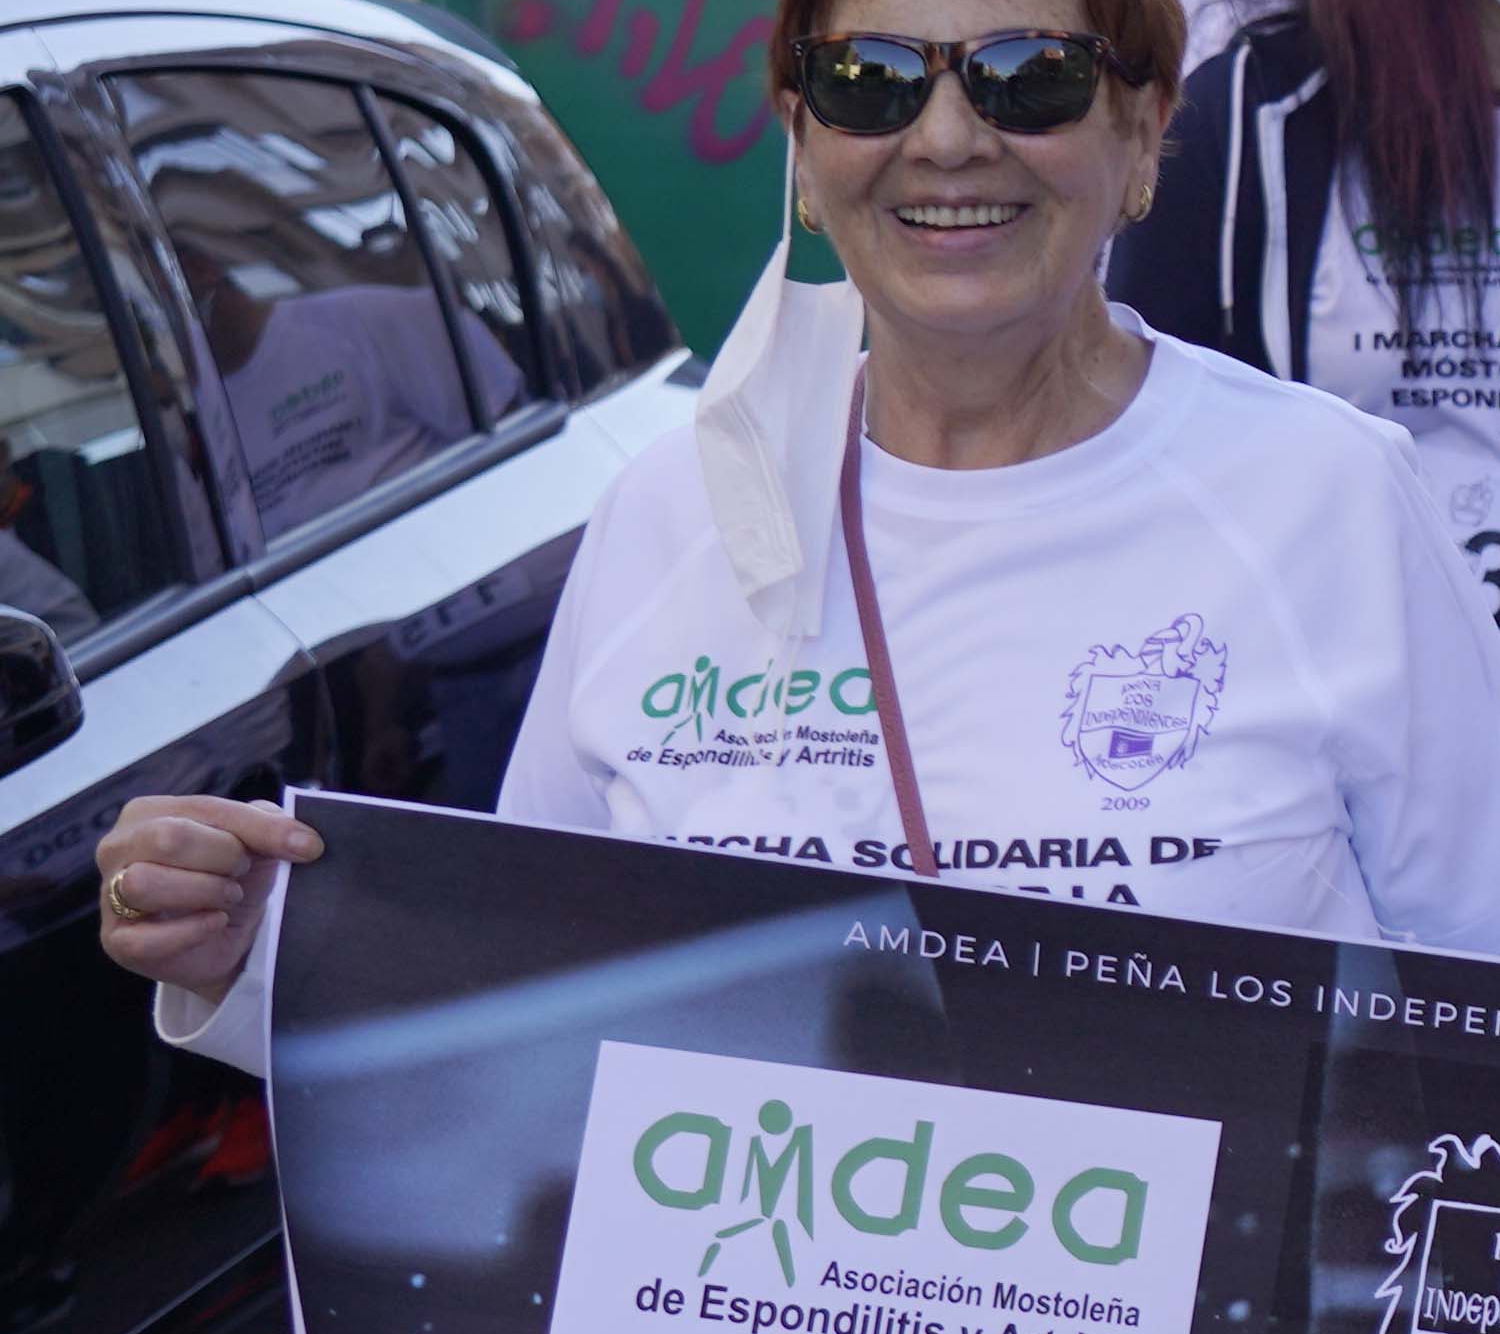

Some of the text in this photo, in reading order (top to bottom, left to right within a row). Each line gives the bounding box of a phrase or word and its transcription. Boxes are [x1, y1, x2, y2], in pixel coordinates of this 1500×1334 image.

[796, 726, 880, 746] Mostoleña
[627, 747, 653, 763] de
[777, 750, 791, 769] y
[796, 746, 876, 768] Artritis
[1100, 797, 1150, 812] 2009
[843, 920, 1010, 969] AMDEA
[1065, 950, 1188, 993] PEÑA
[1211, 970, 1293, 1007] LOS
[635, 1277, 686, 1315] de
[820, 1261, 1141, 1327] Asociación Mostoleña
